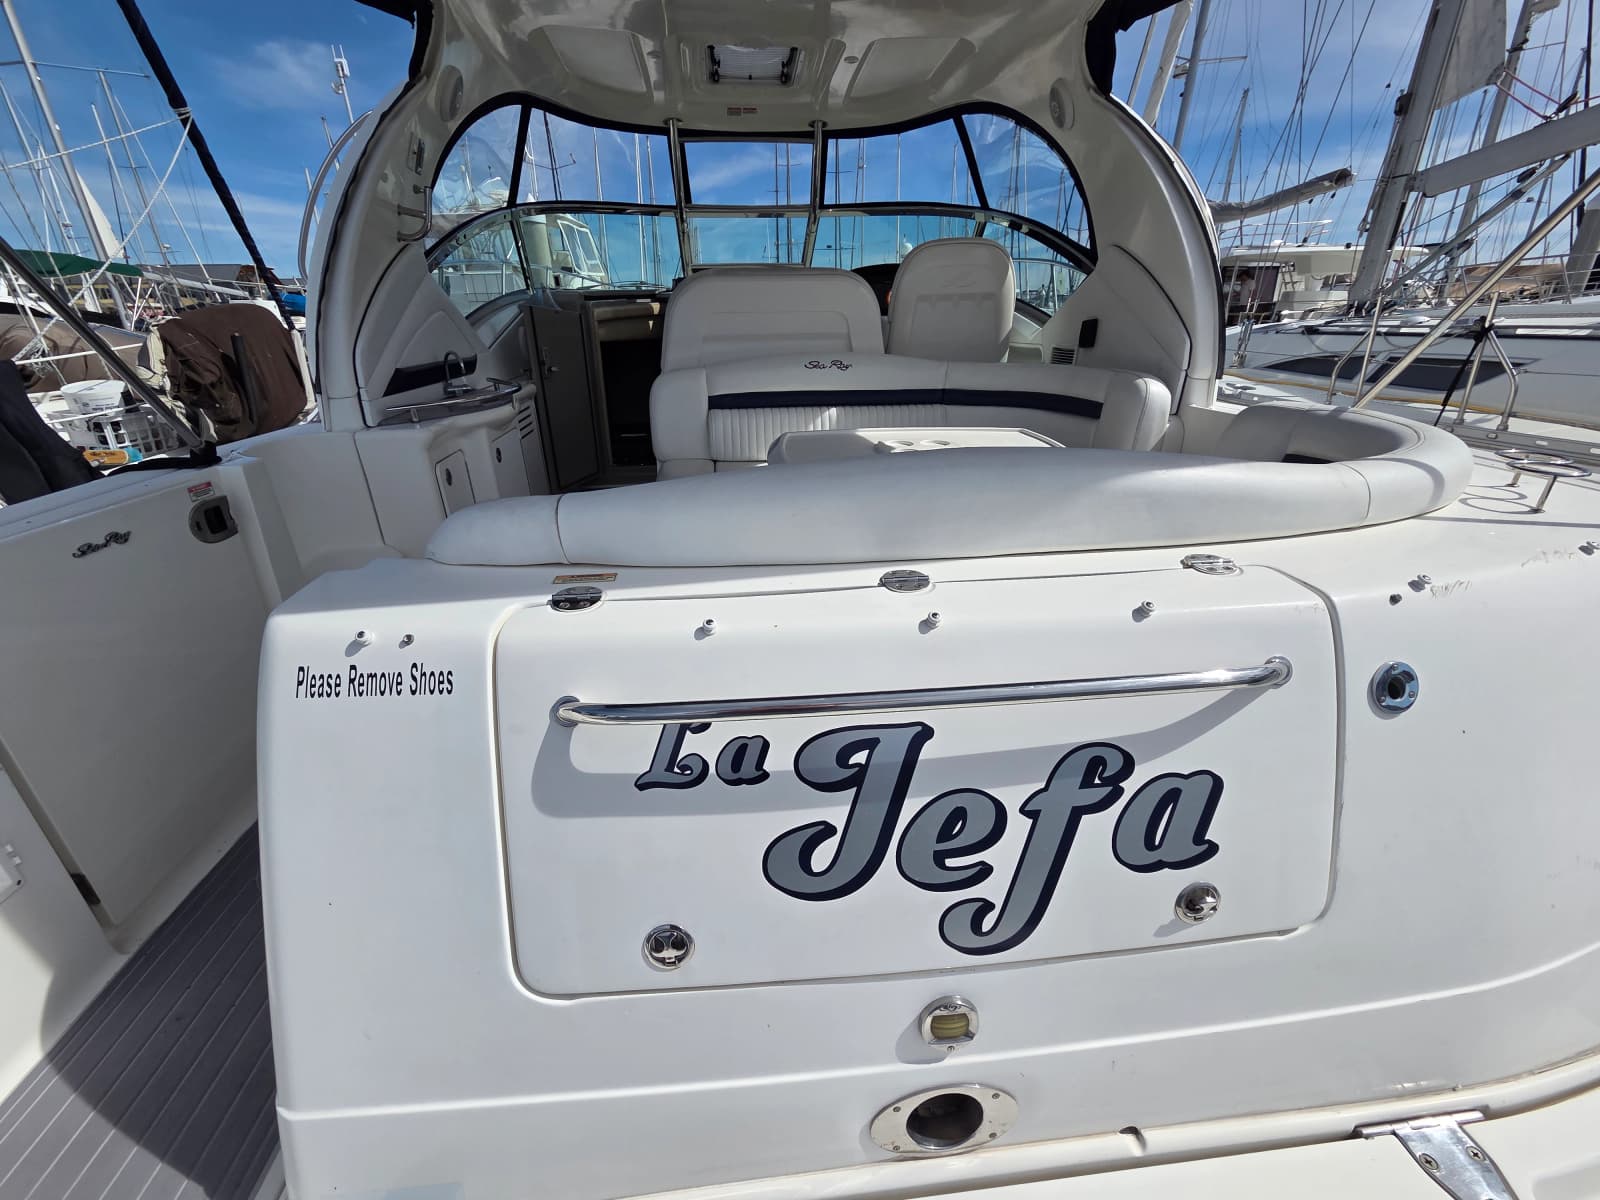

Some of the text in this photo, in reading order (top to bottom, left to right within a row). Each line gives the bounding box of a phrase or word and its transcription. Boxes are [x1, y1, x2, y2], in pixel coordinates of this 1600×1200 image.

[804, 359, 852, 371] Sea Ray
[296, 662, 454, 698] Please Remove Shoes
[634, 721, 1224, 956] La Jefa
